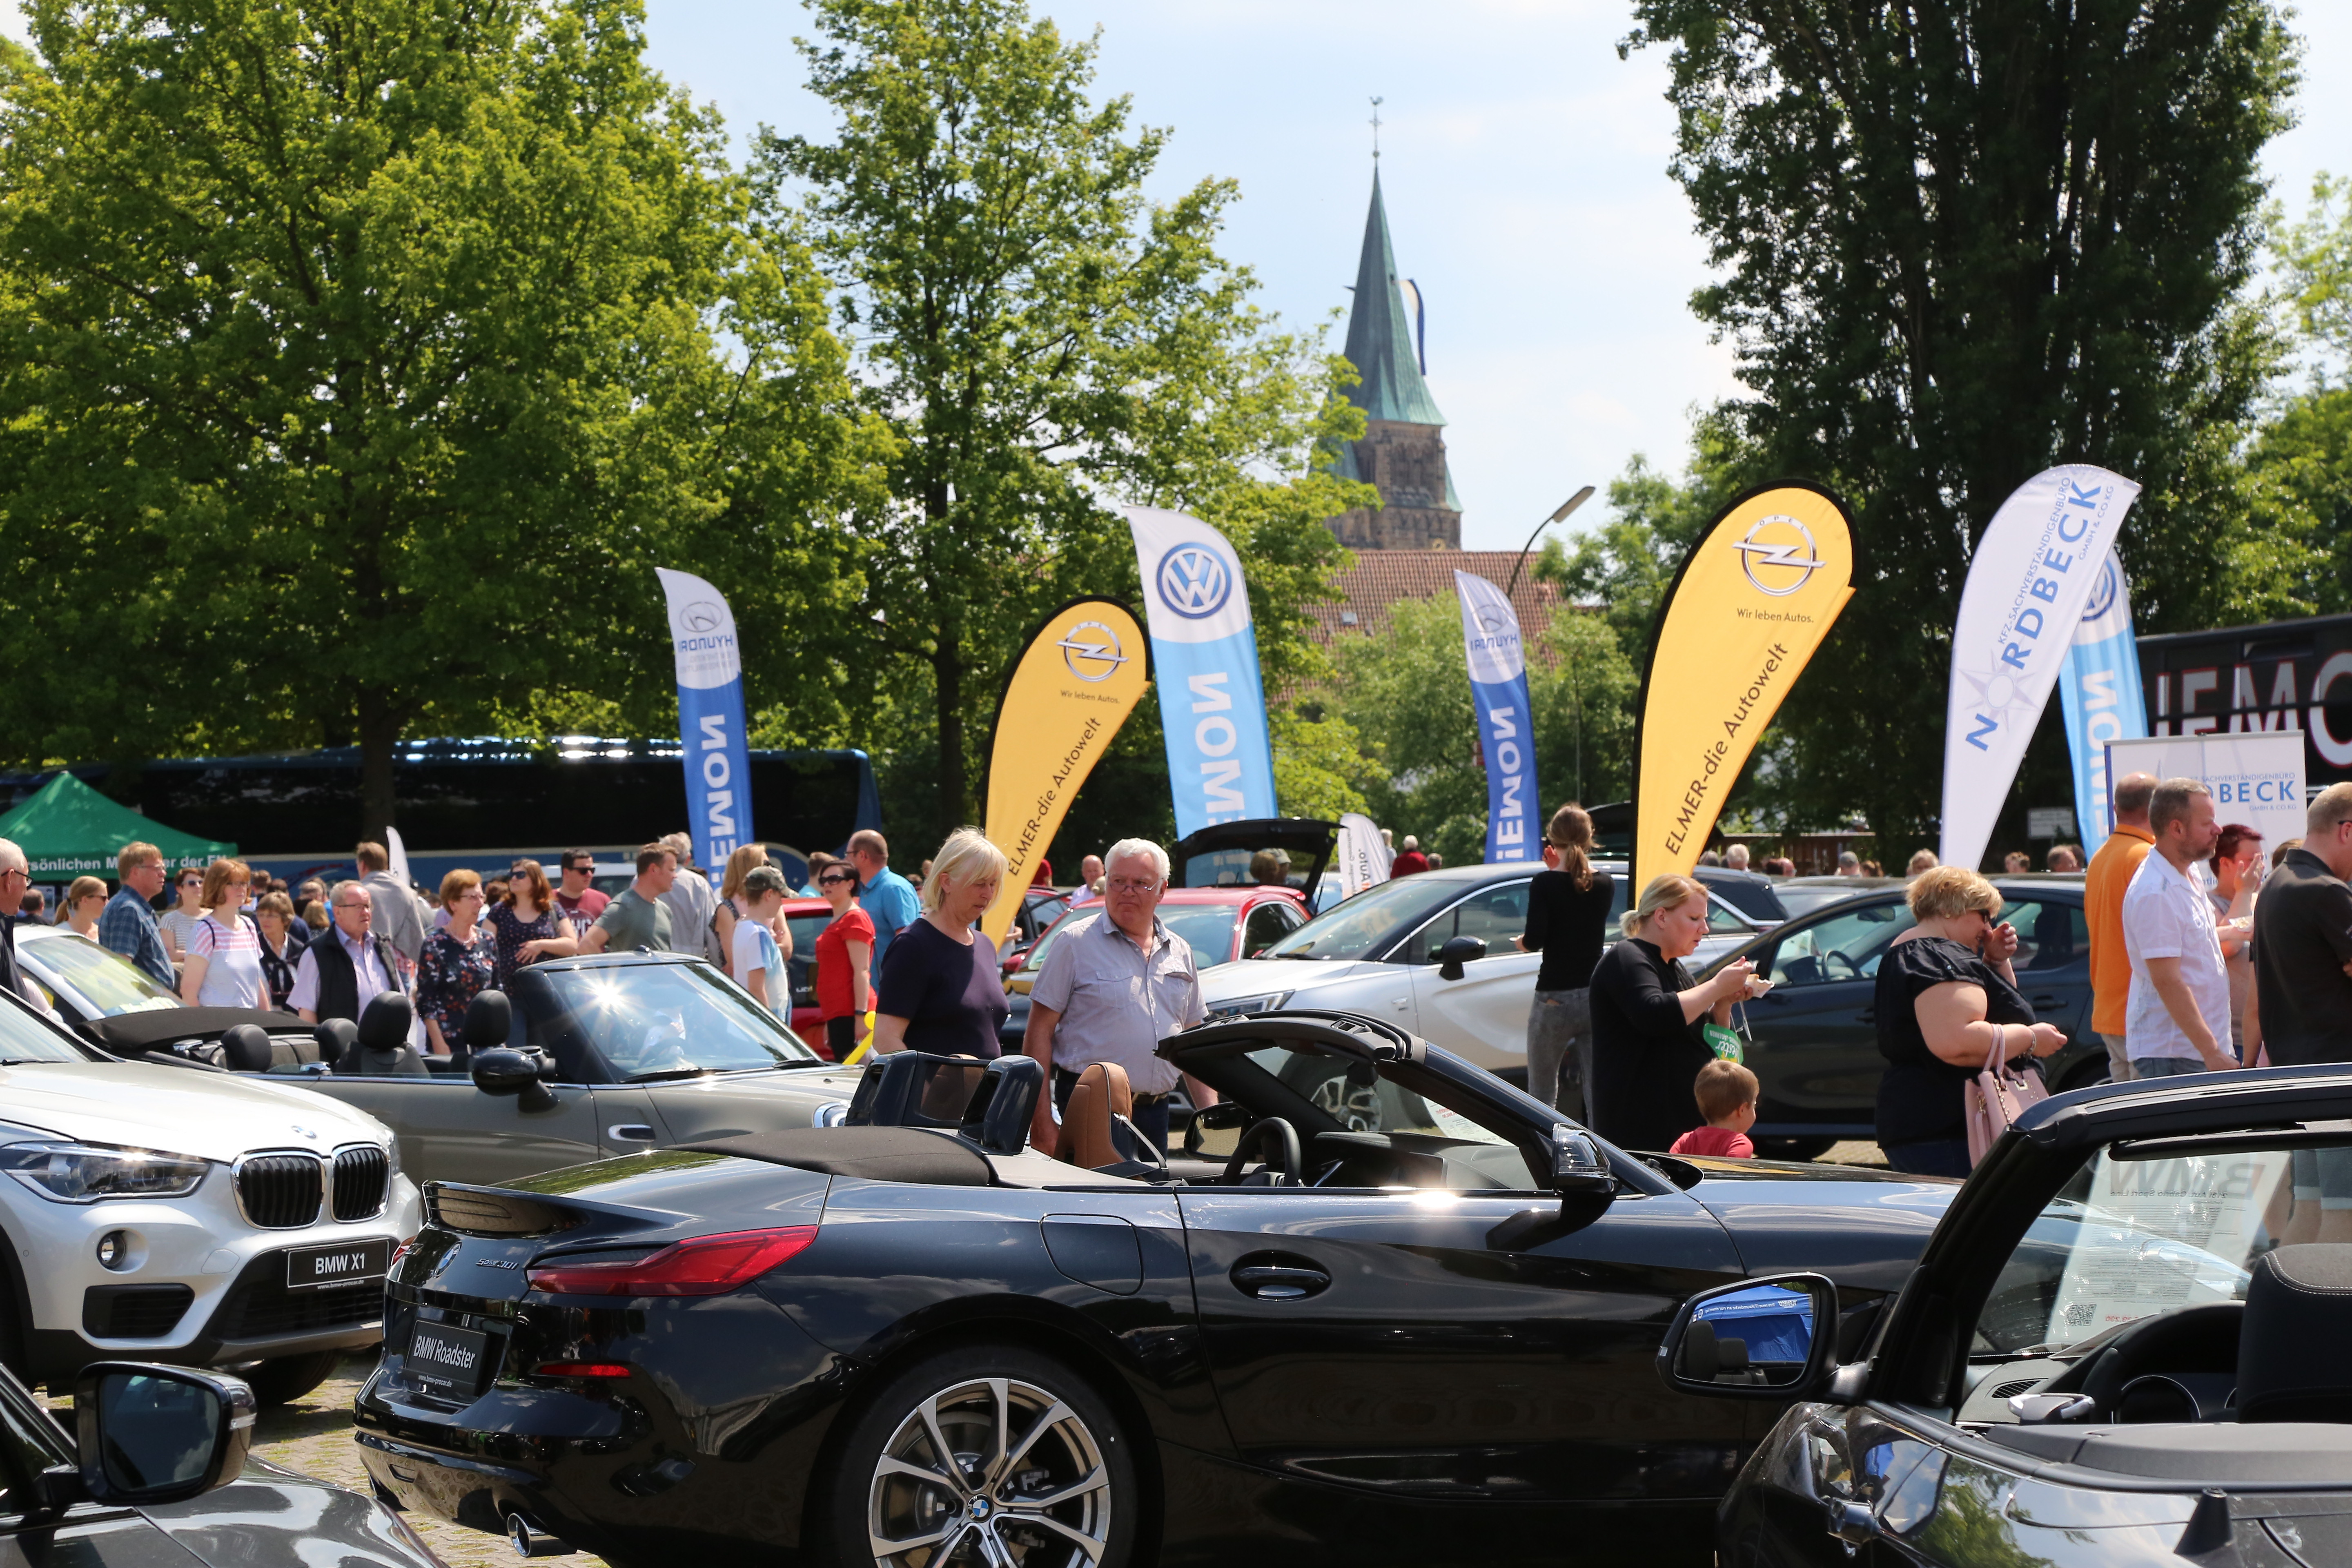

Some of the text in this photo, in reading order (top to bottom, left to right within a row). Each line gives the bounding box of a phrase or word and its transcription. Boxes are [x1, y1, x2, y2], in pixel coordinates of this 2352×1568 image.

[1737, 607, 1814, 624] Wir leben Autos.
[1060, 689, 1120, 704] Wir leben Autos.
[1665, 641, 1788, 855] ELMER-die Autowelt
[1008, 717, 1102, 876] ELMER-die Autowelt
[28, 857, 101, 871] sönlichen
[180, 855, 204, 868] der
[315, 1253, 365, 1274] BMW X1
[317, 1279, 364, 1290] www.bmw-procar.de
[413, 1335, 476, 1368] BMW Roadster
[418, 1375, 452, 1387] www.bmw-procar.de
